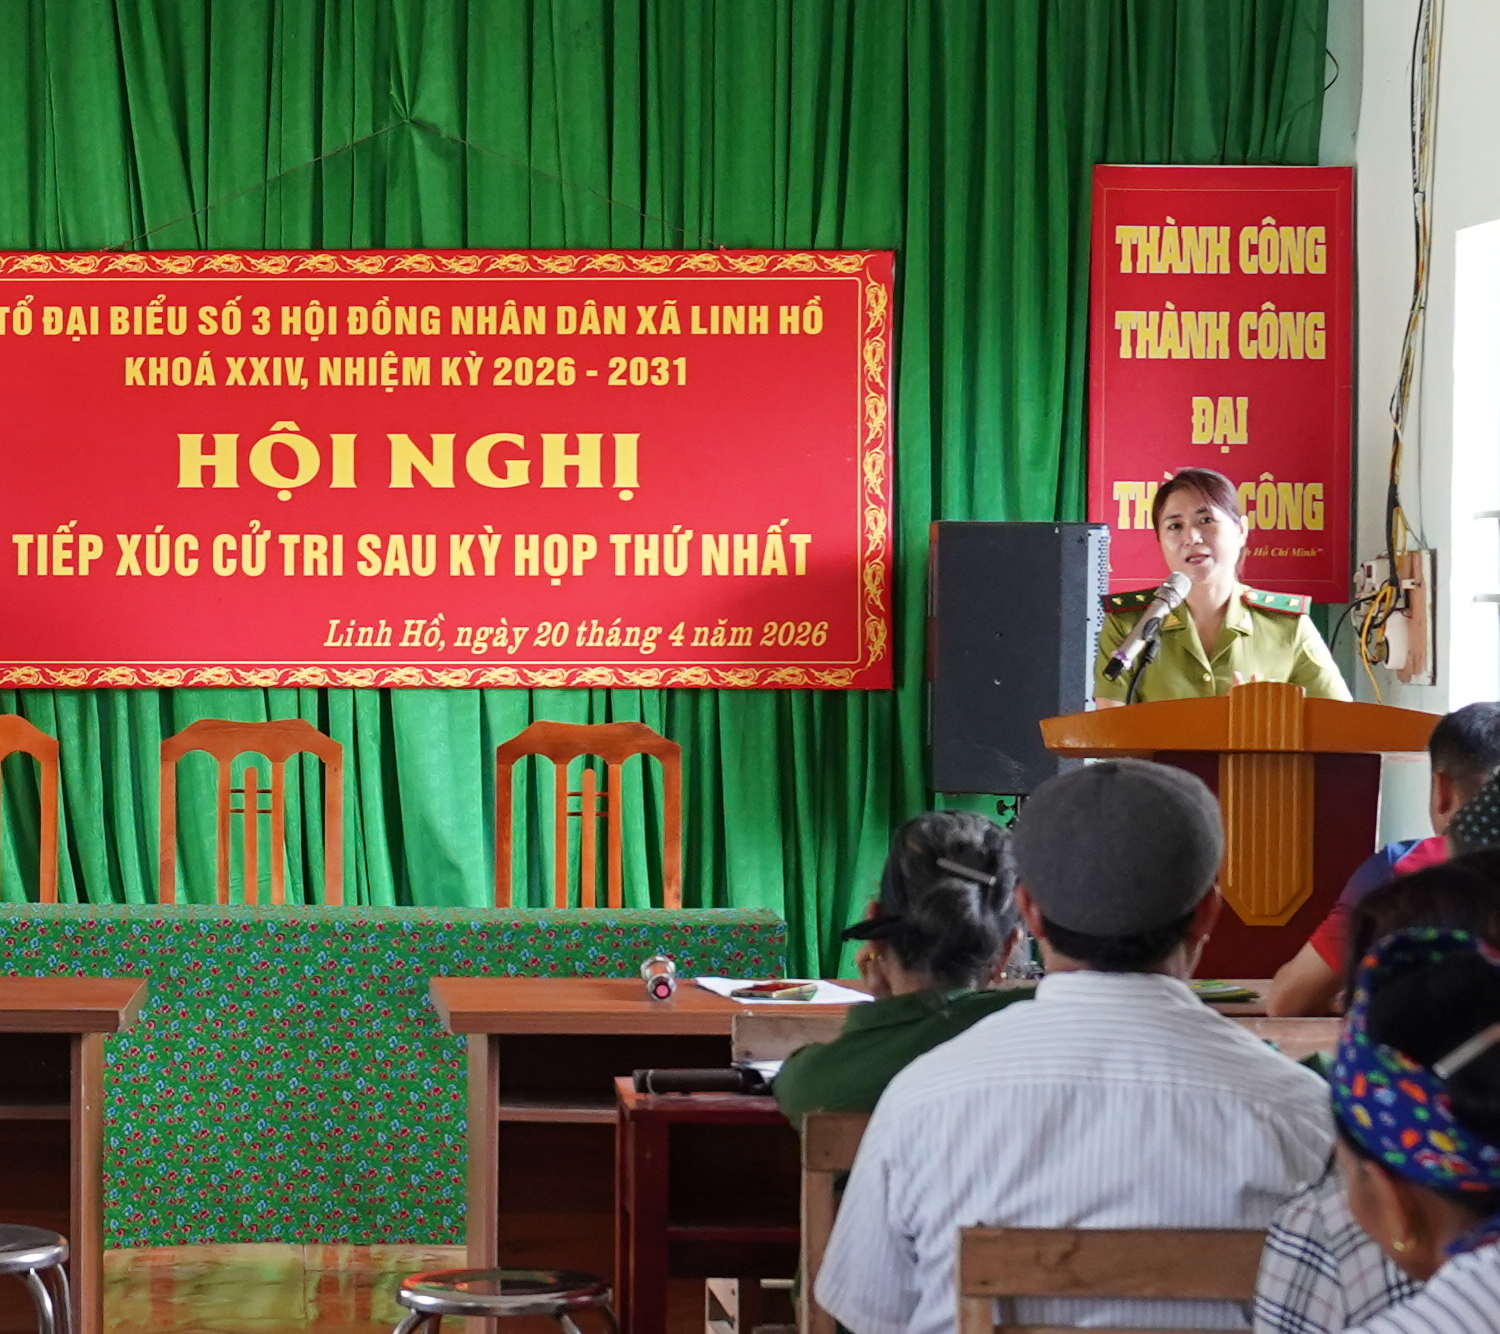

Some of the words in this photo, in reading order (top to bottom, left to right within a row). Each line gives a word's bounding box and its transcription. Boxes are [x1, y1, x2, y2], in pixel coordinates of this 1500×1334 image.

[1115, 215, 1231, 274] THÀNH
[1239, 215, 1327, 274] CÔNG
[41, 305, 100, 342] ĐẠI
[109, 294, 188, 336] BIỂU
[197, 295, 243, 336] SỐ
[251, 305, 271, 336] 3
[281, 299, 338, 342] HỘI
[346, 296, 441, 336] ĐỒNG
[451, 299, 546, 335] NHÂN
[556, 299, 626, 335] DÂN
[635, 299, 682, 335] XÃ
[690, 305, 769, 335] LINH
[779, 295, 824, 335] HỒ
[1115, 301, 1230, 359] THÀNH
[1239, 301, 1326, 359] CÔNG
[125, 350, 216, 387] KHOÁ
[225, 356, 309, 390] XXIV,
[319, 350, 431, 393] NHIỆM
[441, 350, 485, 386] KỲ
[492, 356, 576, 387] 2026
[585, 369, 599, 377] -
[607, 356, 687, 386] 2031
[1191, 396, 1248, 453] ĐẠI
[176, 420, 358, 502] HỘI
[386, 432, 641, 502] NGHỊ
[1238, 471, 1325, 530] CÔNG
[12, 520, 104, 576] TIẾP
[115, 524, 199, 577] XÚC
[212, 519, 272, 577] CỬ
[278, 534, 344, 577] TRI
[357, 533, 437, 577] SAU
[449, 525, 502, 577] KỲ
[514, 533, 598, 586] HỌP
[609, 524, 694, 577] THỨ
[702, 518, 812, 576] NHẤT
[323, 619, 392, 647] Linh
[399, 613, 446, 652] Hồ,
[453, 617, 529, 655] ngày
[534, 621, 570, 648] 20
[576, 617, 663, 655] tháng
[668, 621, 686, 647] 4
[692, 619, 753, 647] năm
[760, 621, 829, 647] 2026
